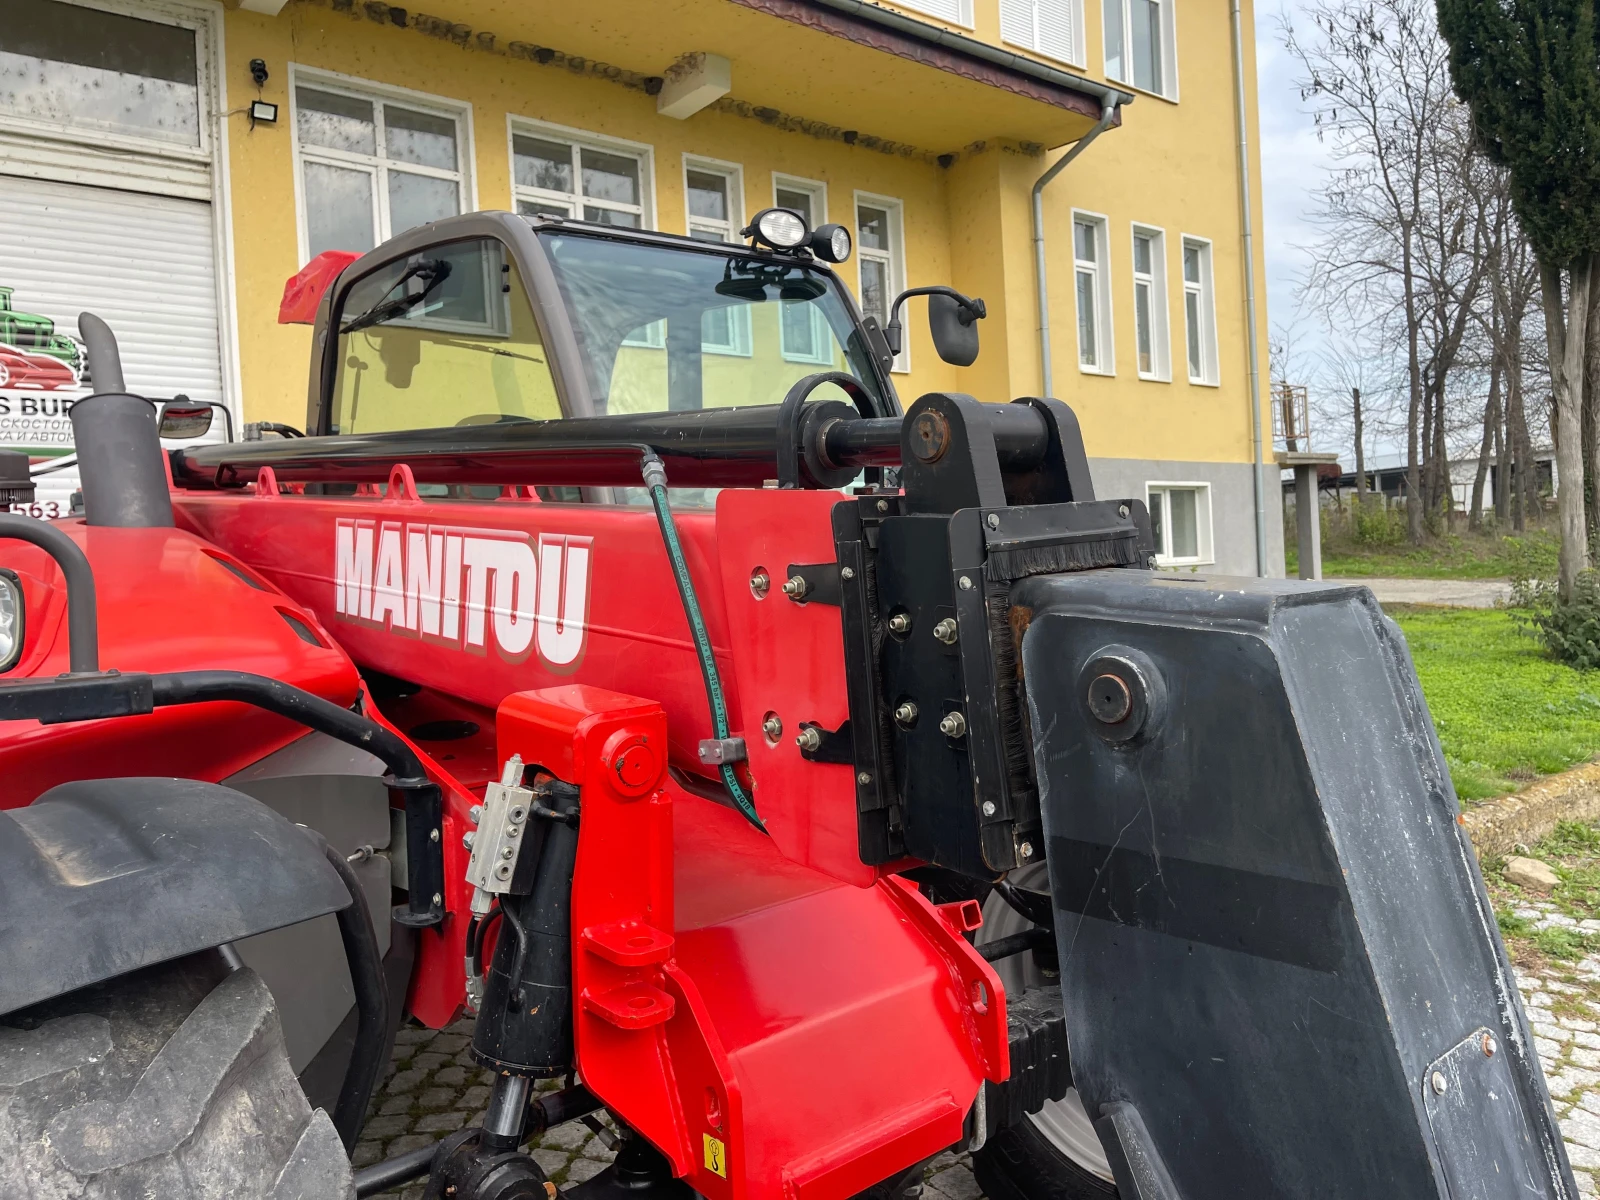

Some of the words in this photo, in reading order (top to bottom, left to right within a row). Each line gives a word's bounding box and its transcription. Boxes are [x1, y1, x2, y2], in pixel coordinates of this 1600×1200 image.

[676, 555, 694, 598] COMPACT
[336, 519, 593, 673] MANITOU
[698, 627, 708, 647] DN12
[709, 672, 718, 686] 345
[712, 687, 720, 700] bar
[727, 774, 737, 787] PSI
